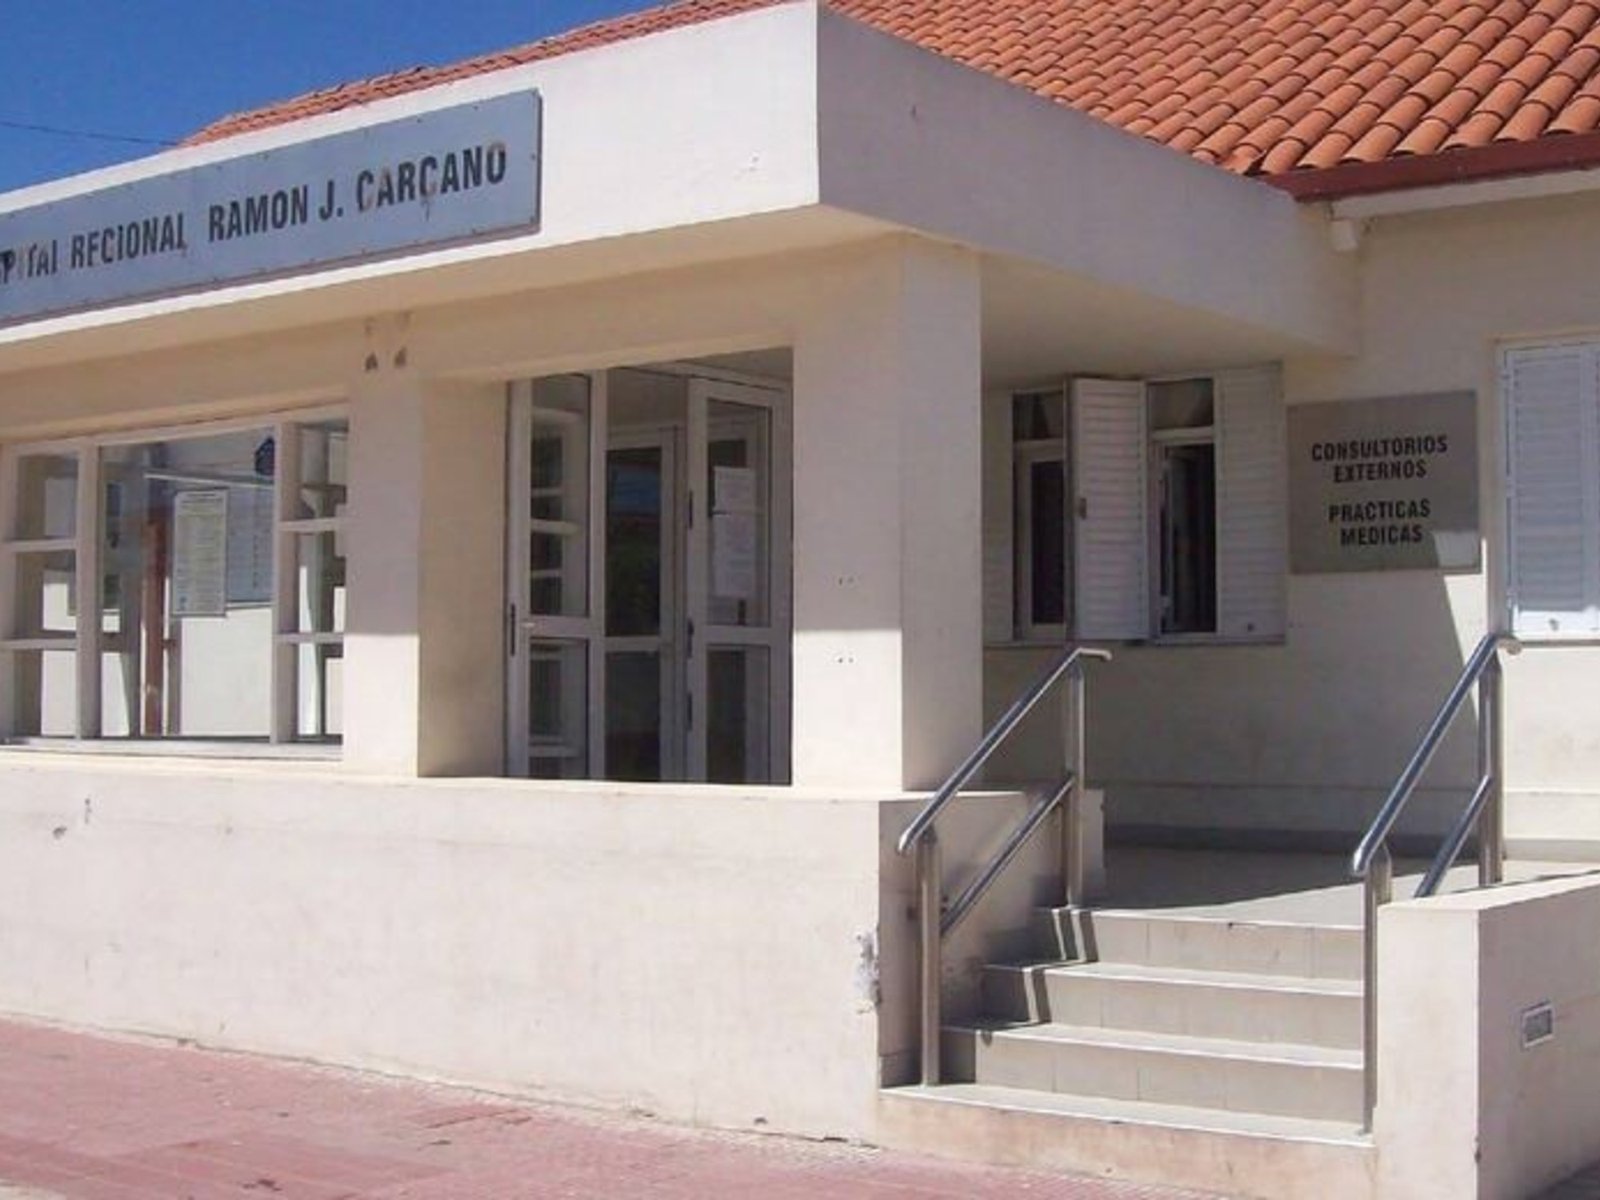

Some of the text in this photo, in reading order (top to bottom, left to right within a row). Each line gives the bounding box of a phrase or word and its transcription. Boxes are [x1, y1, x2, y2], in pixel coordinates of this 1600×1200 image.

[208, 184, 307, 242] RAMON
[319, 180, 343, 220] J.
[356, 142, 506, 213] CARCANO
[1311, 434, 1448, 462] CONSULTORIOS
[1333, 459, 1427, 484] EXTERNOS
[1328, 498, 1431, 523] PRACTICAS
[1340, 524, 1423, 547] MEDICAS
